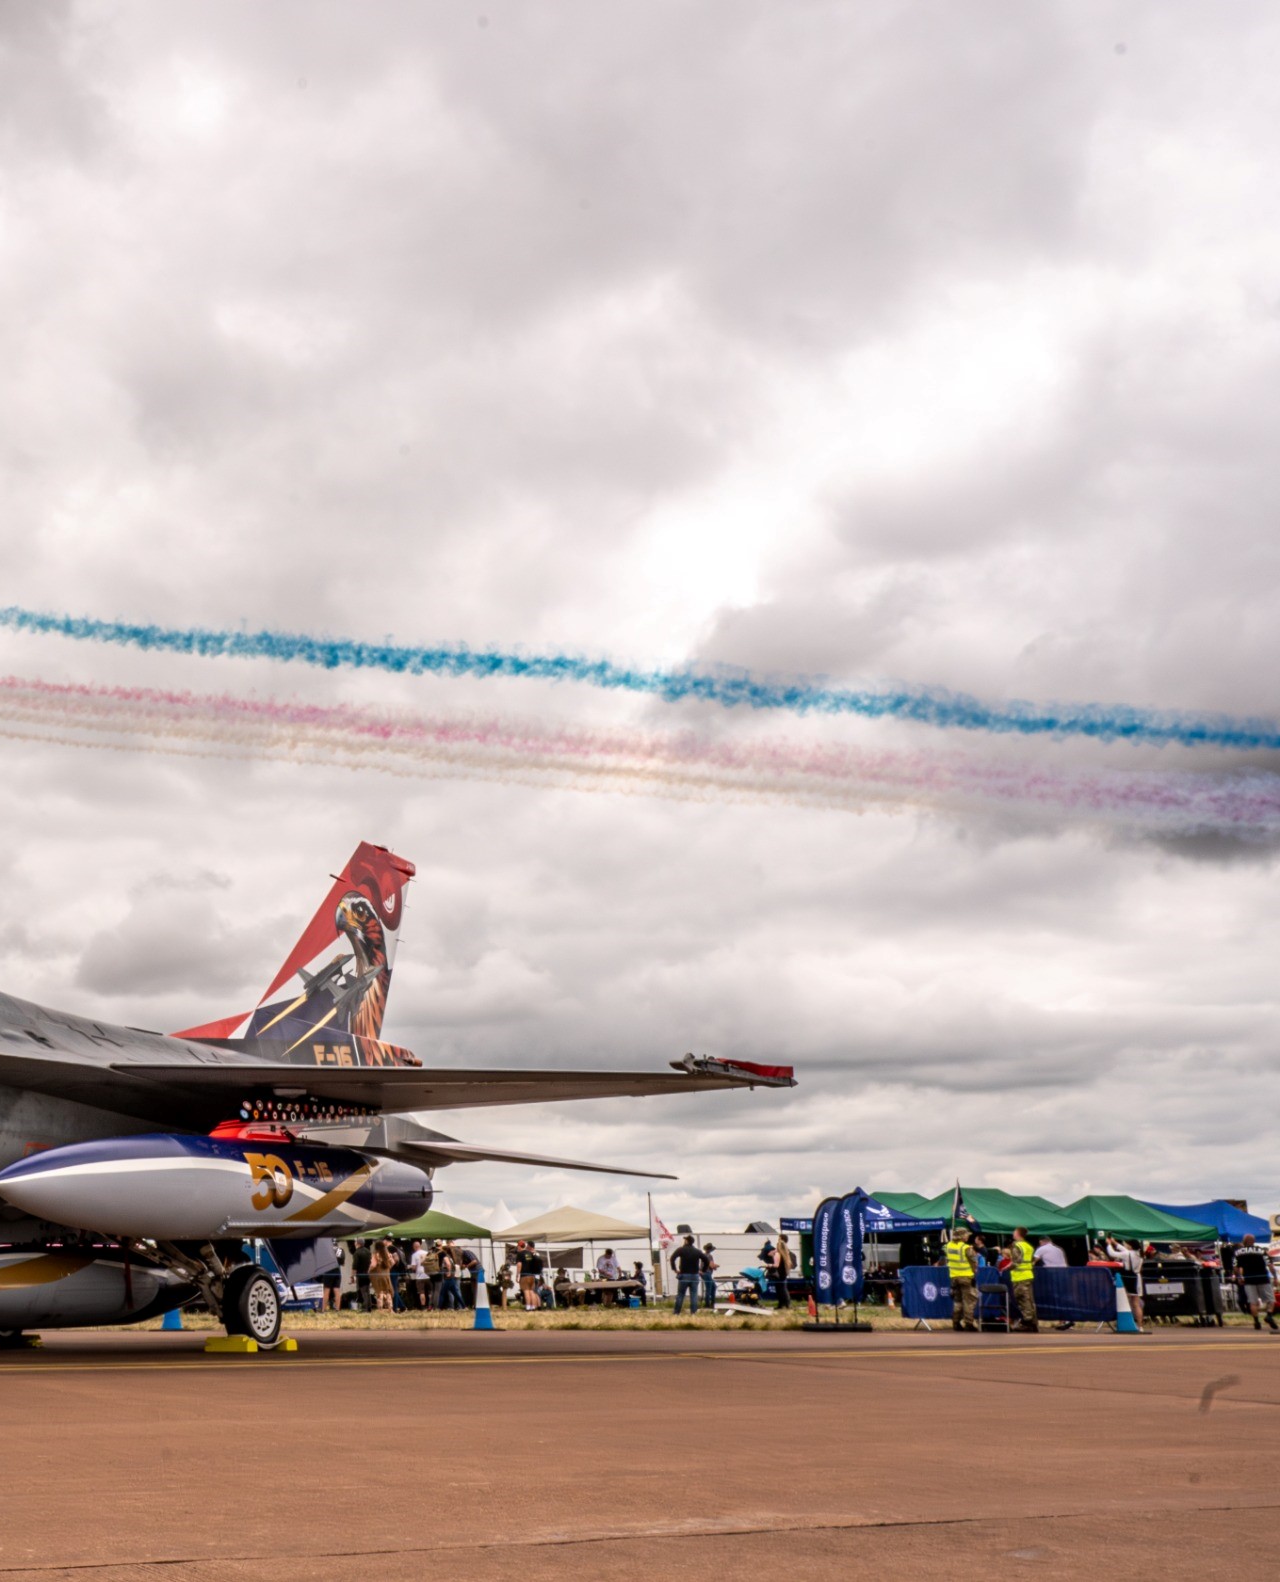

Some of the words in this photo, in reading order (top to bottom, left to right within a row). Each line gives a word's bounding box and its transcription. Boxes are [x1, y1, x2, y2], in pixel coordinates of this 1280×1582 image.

[313, 1044, 353, 1066] F-16
[242, 1152, 294, 1211] 50
[293, 1160, 334, 1183] F-16
[820, 1212, 829, 1254] Aerospace
[843, 1209, 854, 1249] Aerospace
